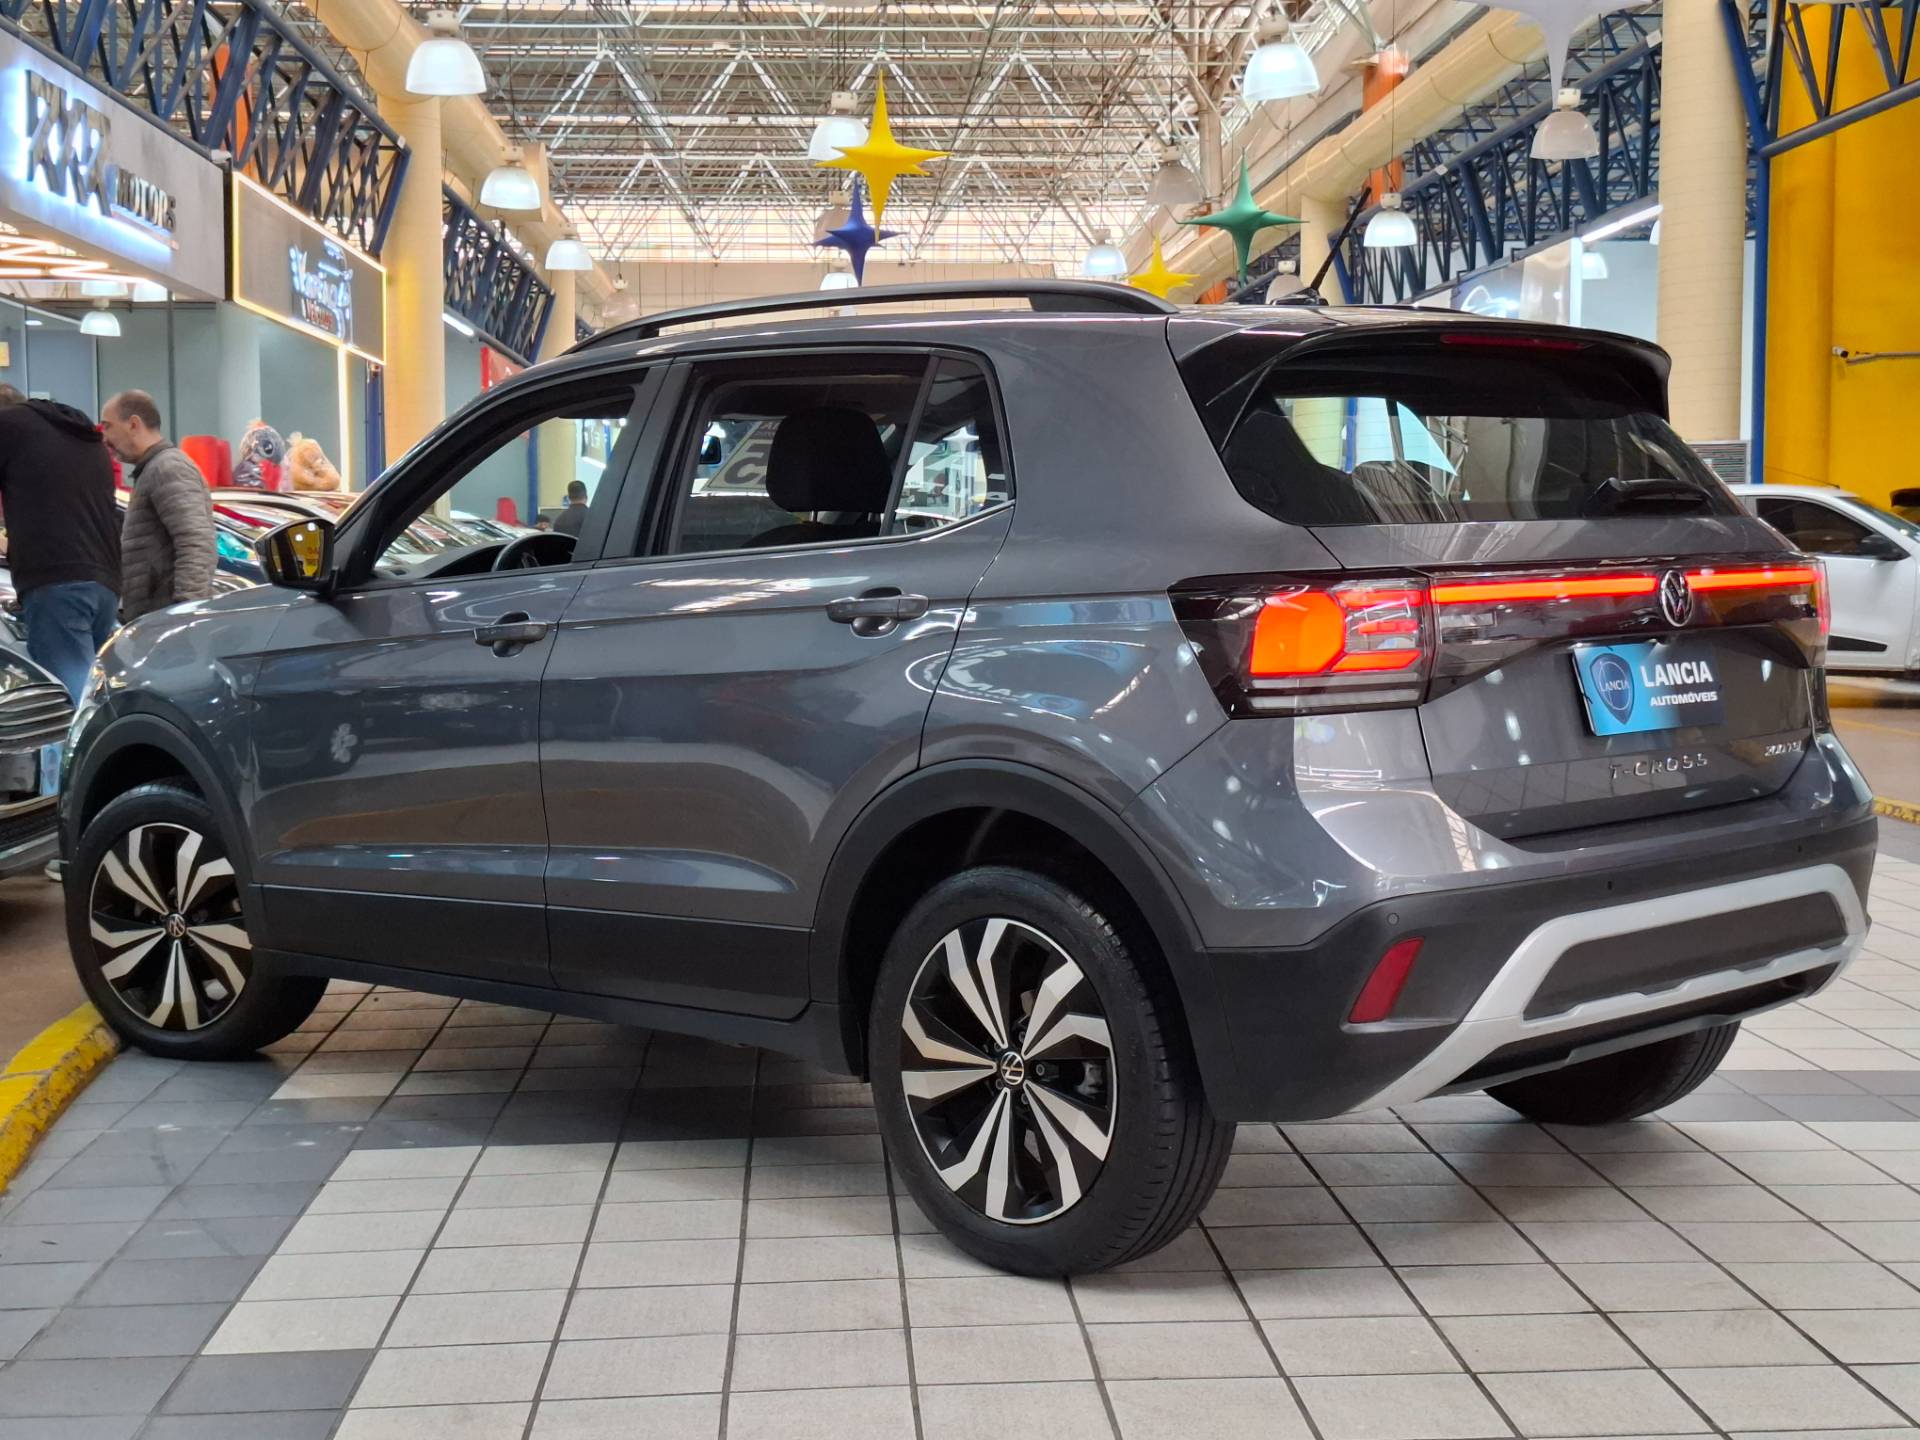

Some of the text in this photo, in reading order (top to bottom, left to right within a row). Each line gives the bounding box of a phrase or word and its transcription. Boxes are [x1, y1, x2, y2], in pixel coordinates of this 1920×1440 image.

[111, 166, 176, 234] MOTORS
[1600, 679, 1630, 692] LANCIA
[1640, 660, 1713, 688] LANCIA
[1650, 691, 1718, 707] AUTOMÓVEIS
[1610, 753, 1708, 779] T-CROSS
